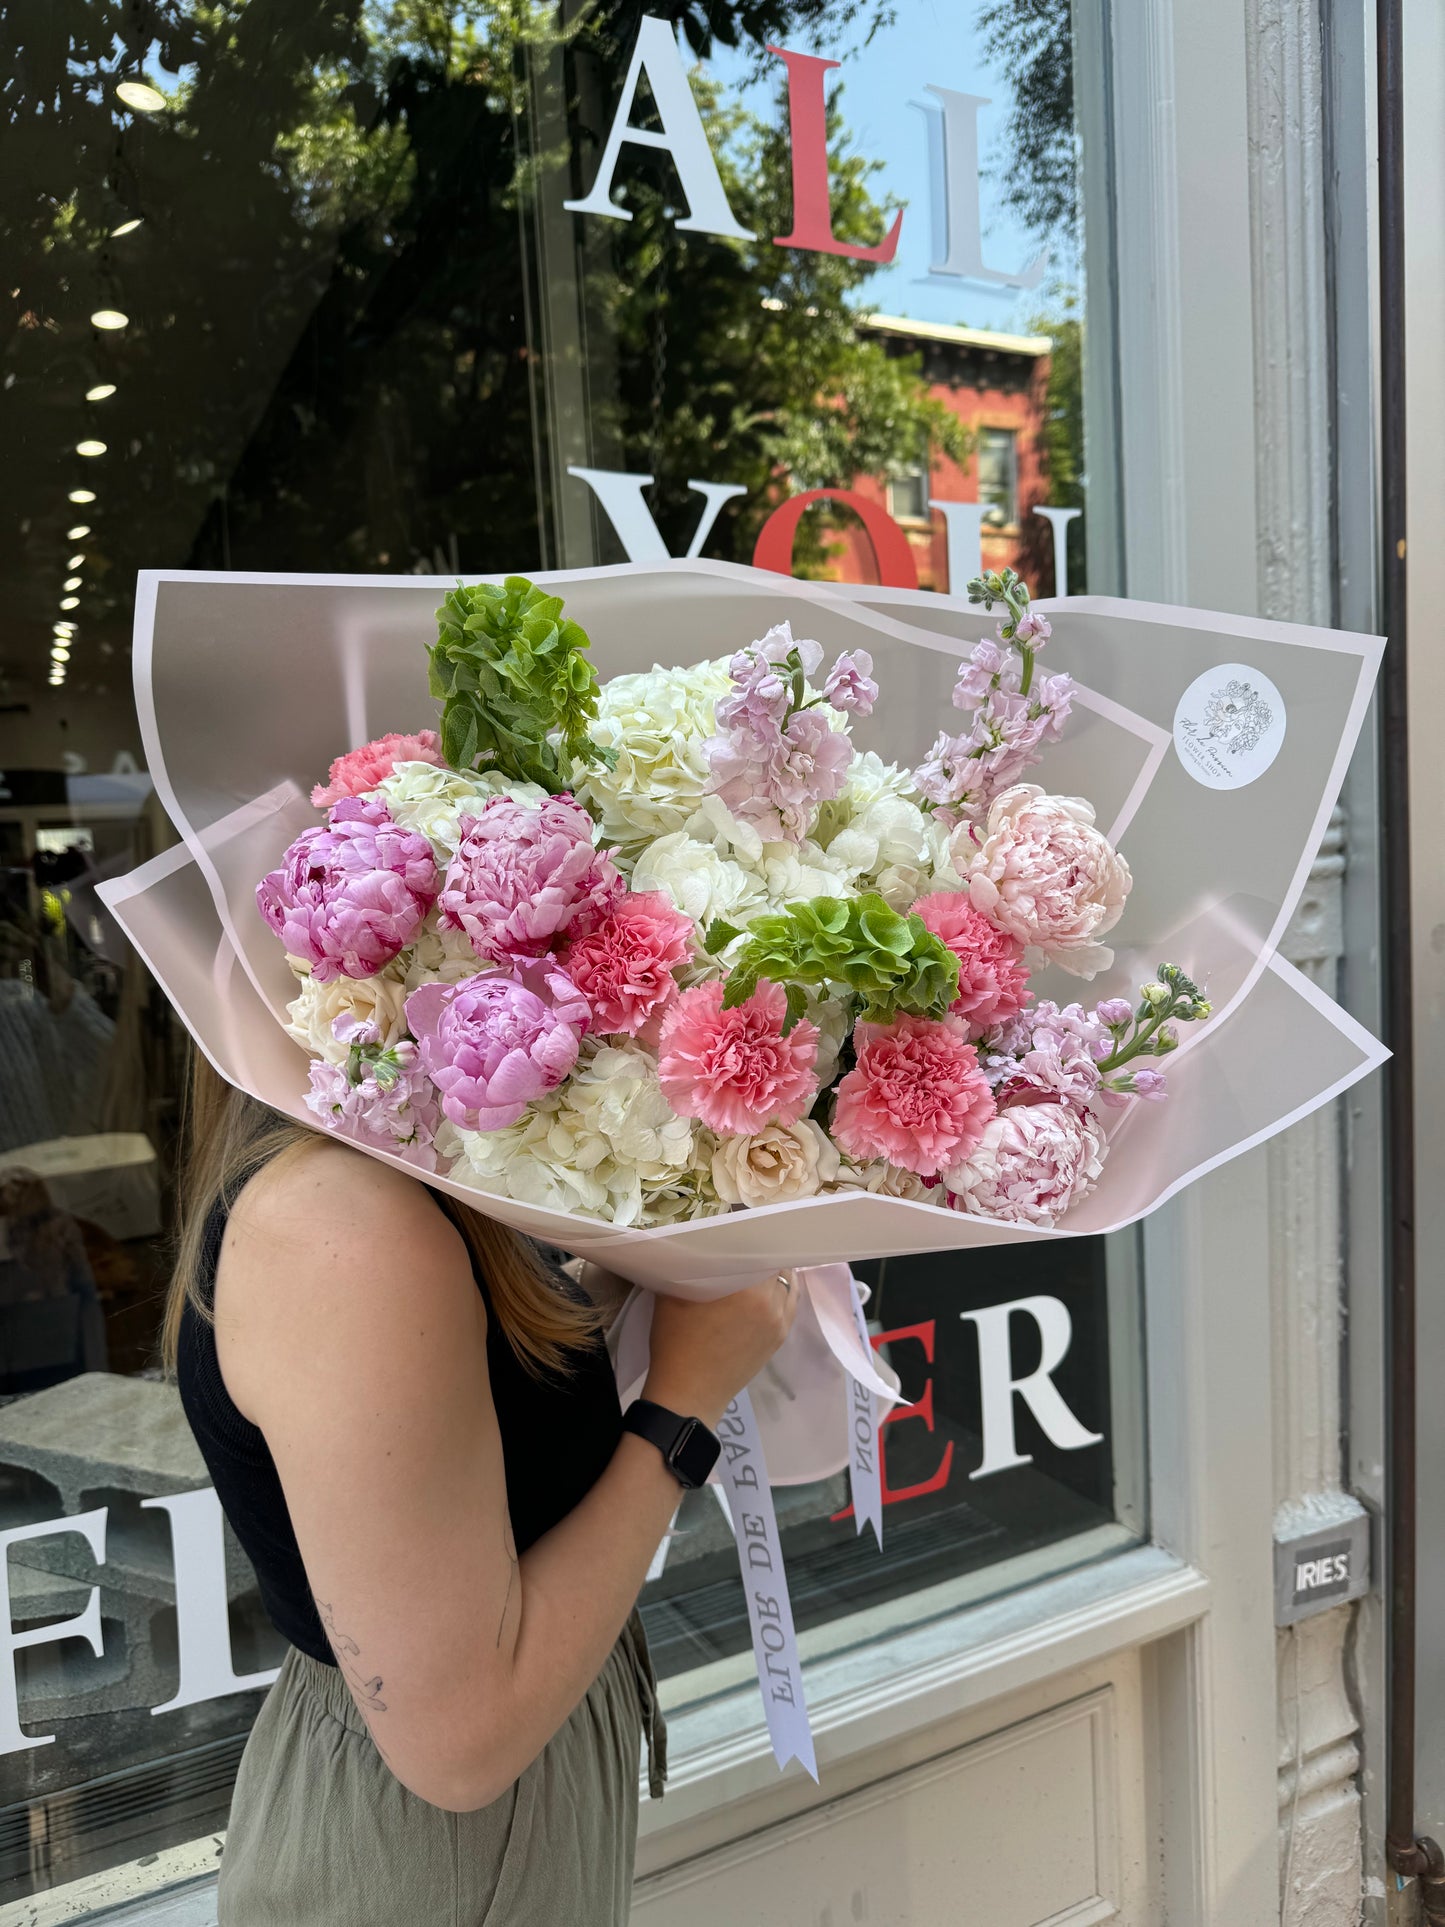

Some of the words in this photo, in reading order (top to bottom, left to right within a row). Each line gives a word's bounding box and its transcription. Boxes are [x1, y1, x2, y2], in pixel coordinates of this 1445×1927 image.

[563, 15, 1047, 291] ALL
[1182, 735, 1205, 760] FLOWER
[1205, 760, 1222, 778] SHOP
